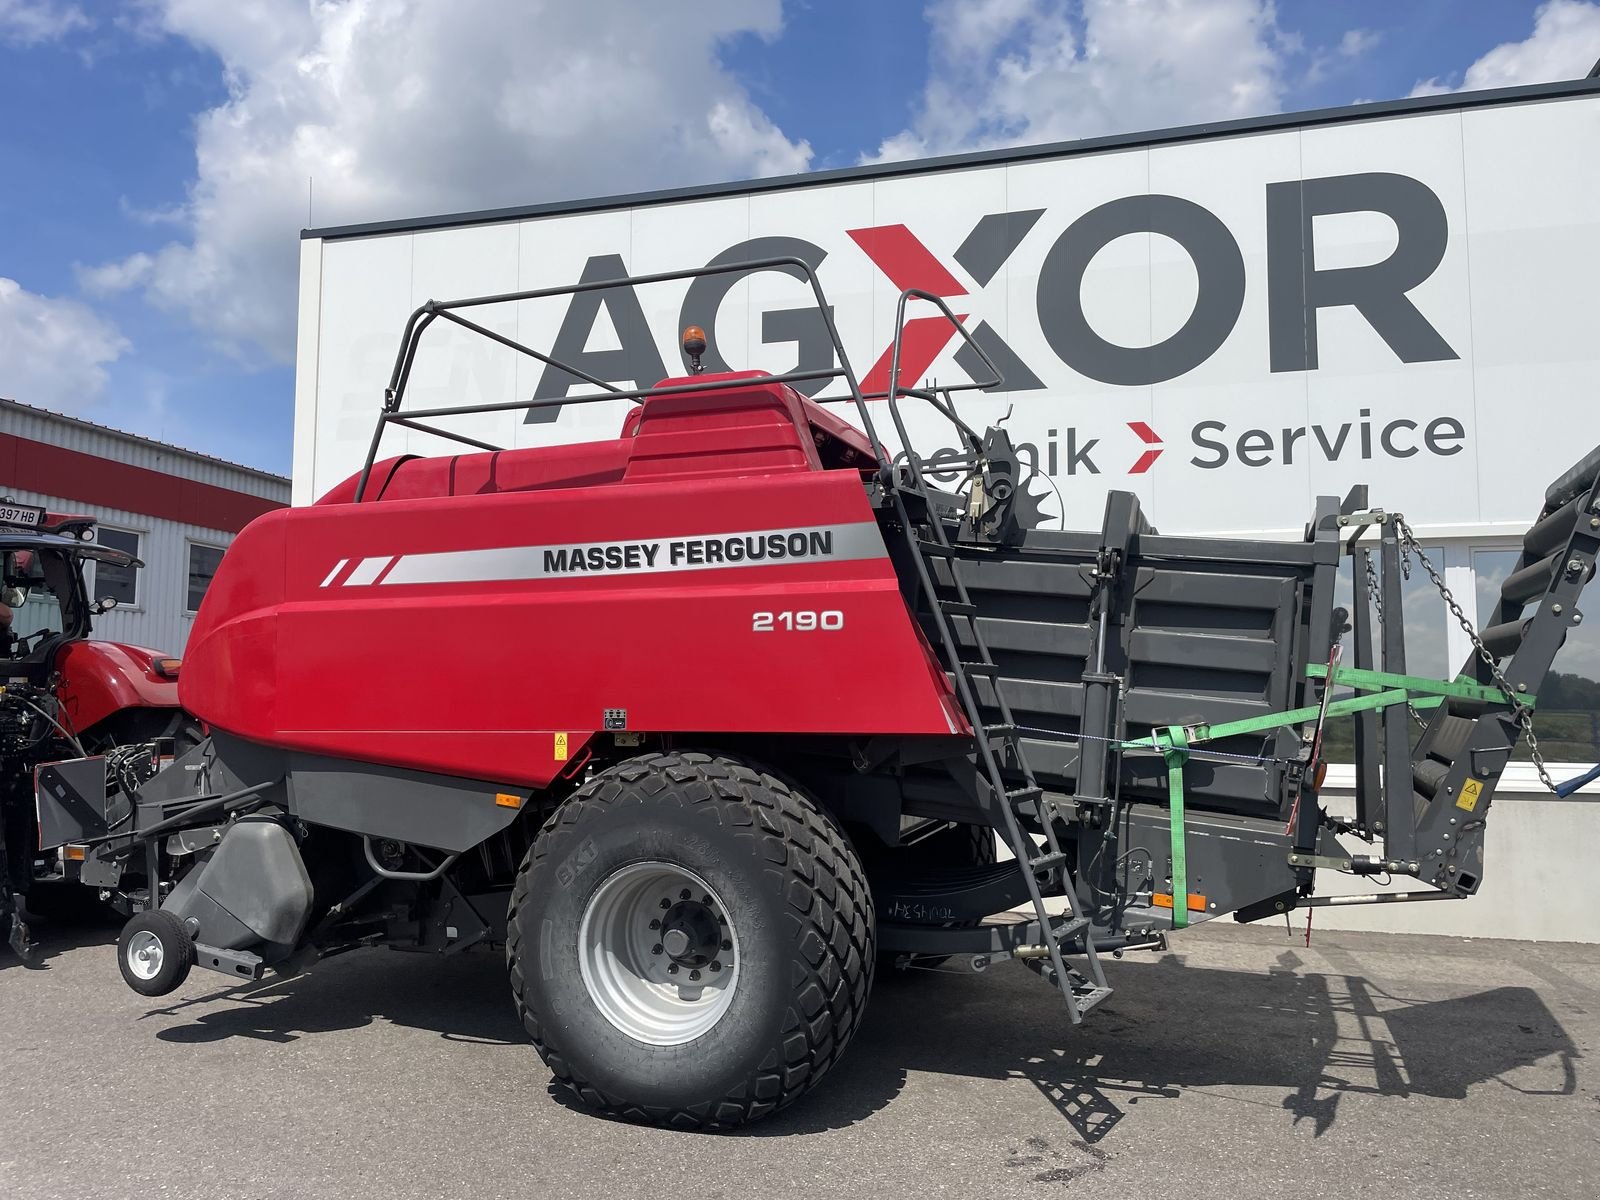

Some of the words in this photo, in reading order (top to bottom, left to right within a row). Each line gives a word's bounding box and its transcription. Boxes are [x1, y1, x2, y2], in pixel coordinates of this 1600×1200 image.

[523, 172, 1460, 424] AGXOR
[1190, 408, 1465, 469] Service
[20, 511, 35, 523] HB
[543, 544, 660, 573] MASSEY
[669, 531, 834, 566] FERGUSON
[752, 610, 845, 632] 2190
